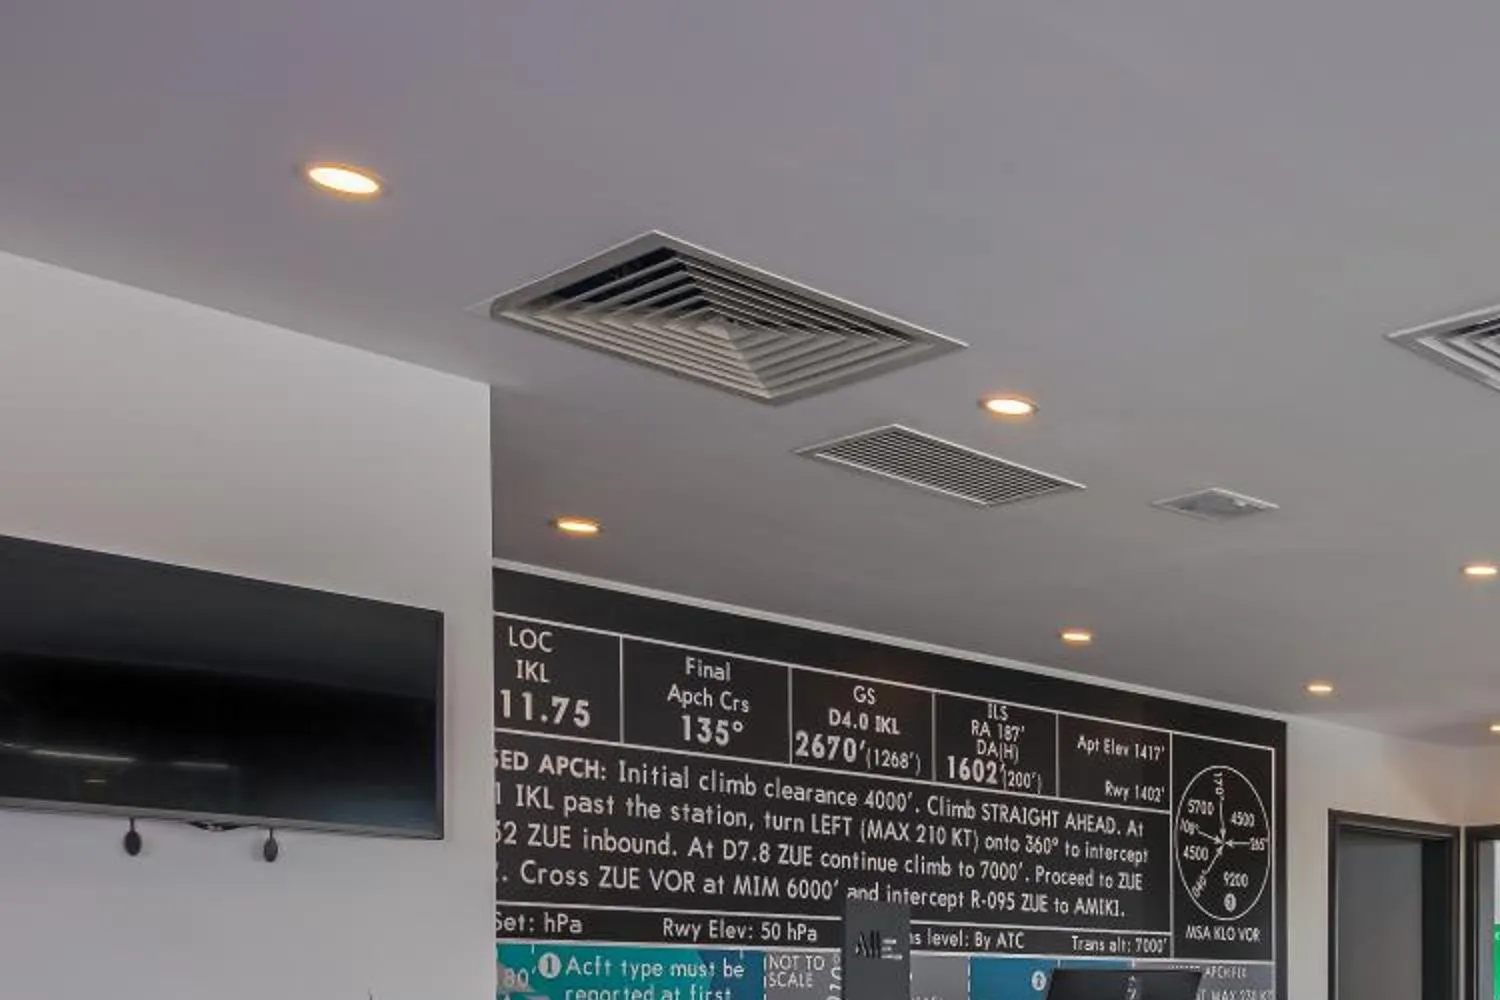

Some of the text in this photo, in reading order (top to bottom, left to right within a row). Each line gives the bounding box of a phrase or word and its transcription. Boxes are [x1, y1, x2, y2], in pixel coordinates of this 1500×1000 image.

[509, 625, 553, 653] LOC
[515, 659, 550, 683] IKL
[685, 655, 731, 682] Final
[666, 683, 750, 713] Apch Crs
[852, 685, 877, 705] GS
[828, 707, 901, 735] D4.0 IKL
[987, 703, 1009, 721] ILS
[681, 714, 744, 746] 135°
[970, 719, 991, 737] RA
[1077, 735, 1100, 755] Apt
[1103, 738, 1129, 756] Elev
[538, 754, 607, 781] APCH:
[618, 759, 689, 789] Initial
[699, 768, 756, 796] climb
[764, 776, 857, 807] clearance
[927, 795, 977, 820] Climb
[981, 803, 1060, 829] STRAIGHT
[1064, 811, 1121, 836] AHEAD.
[1125, 818, 1144, 837] At
[1105, 780, 1129, 801] Rwy
[515, 783, 555, 810] IKL
[563, 795, 615, 817] past
[626, 793, 662, 820] the
[670, 802, 755, 831] station,
[764, 810, 805, 834] turn
[811, 813, 853, 837] LEFT
[859, 818, 909, 843] (MAX
[915, 823, 947, 846] 210
[951, 827, 979, 854] KT)
[985, 834, 1021, 852] onto
[1025, 834, 1059, 855] 360°
[1064, 840, 1081, 858] to
[1085, 841, 1149, 867] intercept
[527, 823, 571, 849] ZUE
[583, 827, 677, 856] inbound.
[687, 836, 714, 859] At
[723, 839, 771, 864] D7.8
[777, 843, 813, 866] ZUE
[820, 851, 898, 873] continue
[904, 853, 951, 877] climb
[958, 860, 975, 879] to
[1035, 865, 1095, 887] Proceed
[1099, 873, 1113, 889] to
[1117, 871, 1144, 891] ZUE
[519, 859, 590, 887] Cross
[598, 864, 641, 890] ZUE
[648, 868, 695, 894] VOR
[702, 874, 725, 895] at
[732, 874, 780, 898] MIM
[787, 878, 839, 900] 6000'
[846, 881, 879, 901] and
[886, 884, 964, 912] intercept
[971, 889, 1015, 911] R-095
[1021, 893, 1049, 913] ZUE
[1054, 897, 1069, 915] to
[1073, 897, 1126, 917] AMIKI.
[495, 911, 583, 934] Set: hPa
[663, 917, 818, 942] Rwy Elev: 50 hPa
[1185, 925, 1211, 940] MSA
[926, 927, 969, 948] level:
[974, 931, 991, 950] By
[995, 931, 1025, 949] ATC
[1071, 935, 1105, 952] Trans
[1109, 936, 1131, 953] alt:
[565, 955, 611, 977] Acft
[621, 959, 663, 982] type
[670, 963, 715, 977] must
[723, 957, 745, 978] be
[768, 955, 825, 971] NOT TO
[768, 972, 813, 988] SCALE
